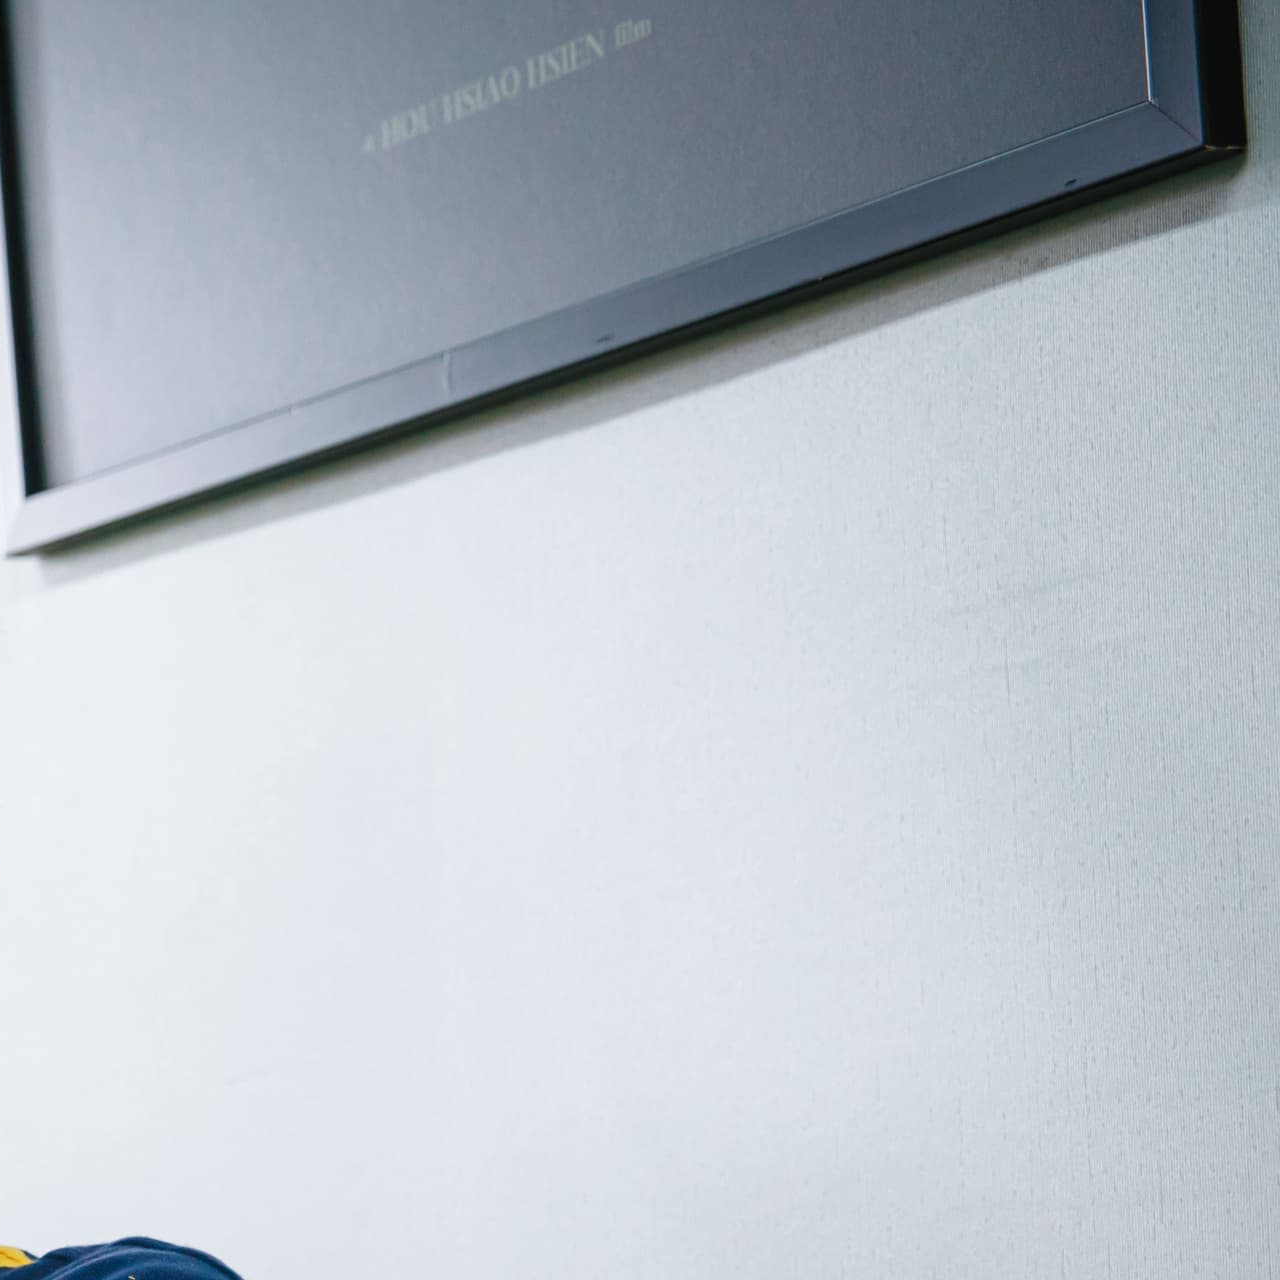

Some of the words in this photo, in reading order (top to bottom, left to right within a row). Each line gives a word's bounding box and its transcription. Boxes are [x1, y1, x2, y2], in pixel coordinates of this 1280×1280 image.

[381, 101, 440, 150] HOU
[443, 65, 521, 125] HSIAO
[527, 29, 605, 89] HSIEN
